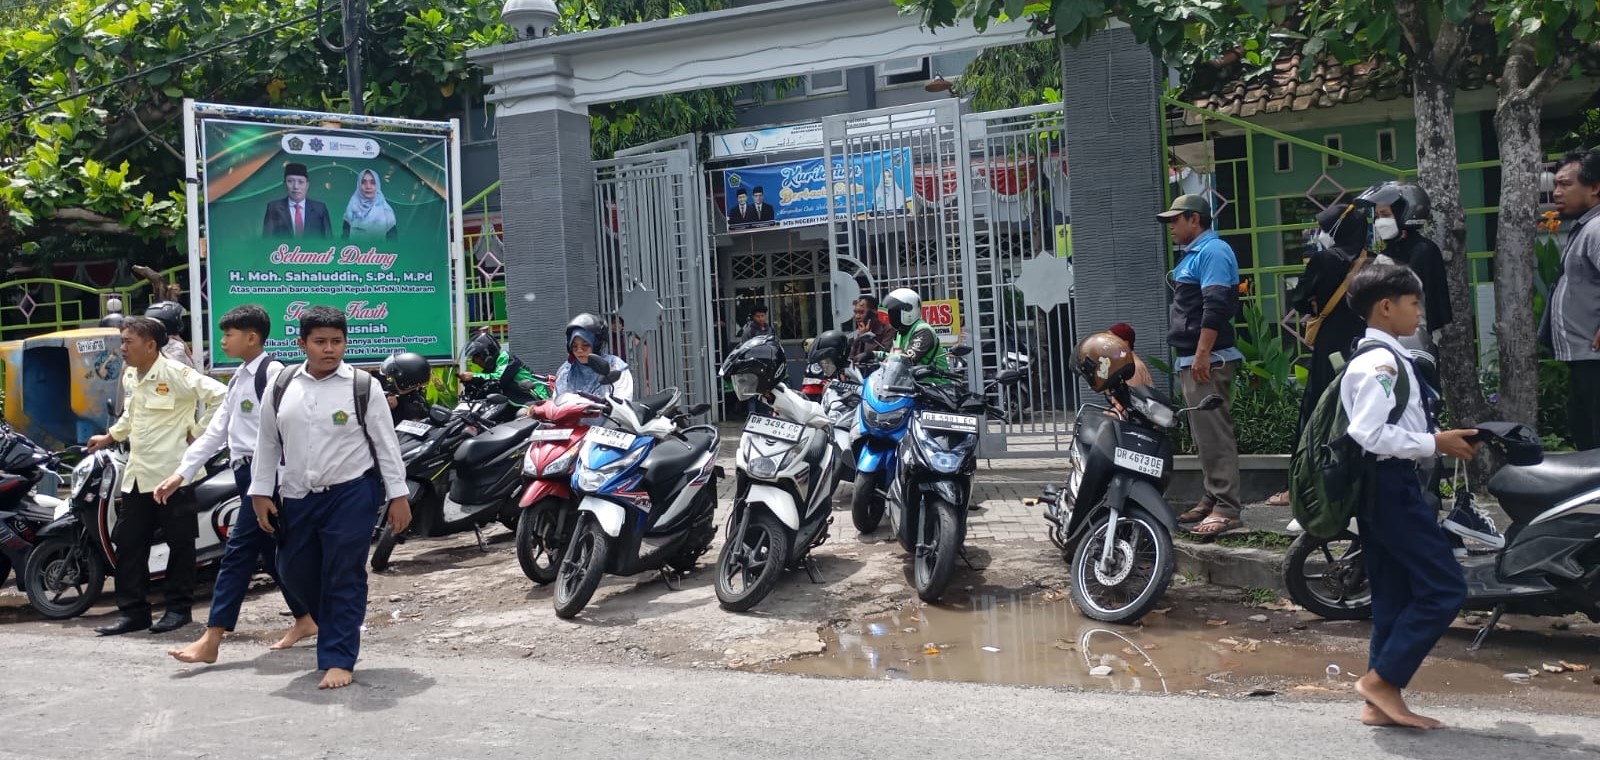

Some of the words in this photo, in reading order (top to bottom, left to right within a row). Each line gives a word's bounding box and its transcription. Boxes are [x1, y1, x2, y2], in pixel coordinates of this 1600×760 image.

[270, 244, 336, 264] Selamat
[338, 245, 398, 270] Datang
[230, 271, 245, 281] H.
[248, 271, 282, 281] Moh.
[285, 271, 363, 283] Sahaluddin,
[366, 272, 400, 283] S.Pd.,
[403, 272, 433, 282] M.Pd
[230, 285, 251, 294] Atas
[252, 285, 288, 294] amanah
[289, 285, 310, 294] baru
[310, 285, 343, 295] sebagai
[344, 285, 372, 295] Kepala
[373, 285, 395, 293] MTsN
[401, 285, 435, 293] Mataram
[346, 300, 389, 320] Kasih
[347, 323, 388, 334] usniah
[264, 339, 289, 347] dikasi
[402, 334, 438, 345] bertugas
[371, 345, 406, 355] Mataram
[751, 416, 762, 424] DR
[1116, 448, 1128, 460] DR
[1129, 452, 1150, 466] 4673
